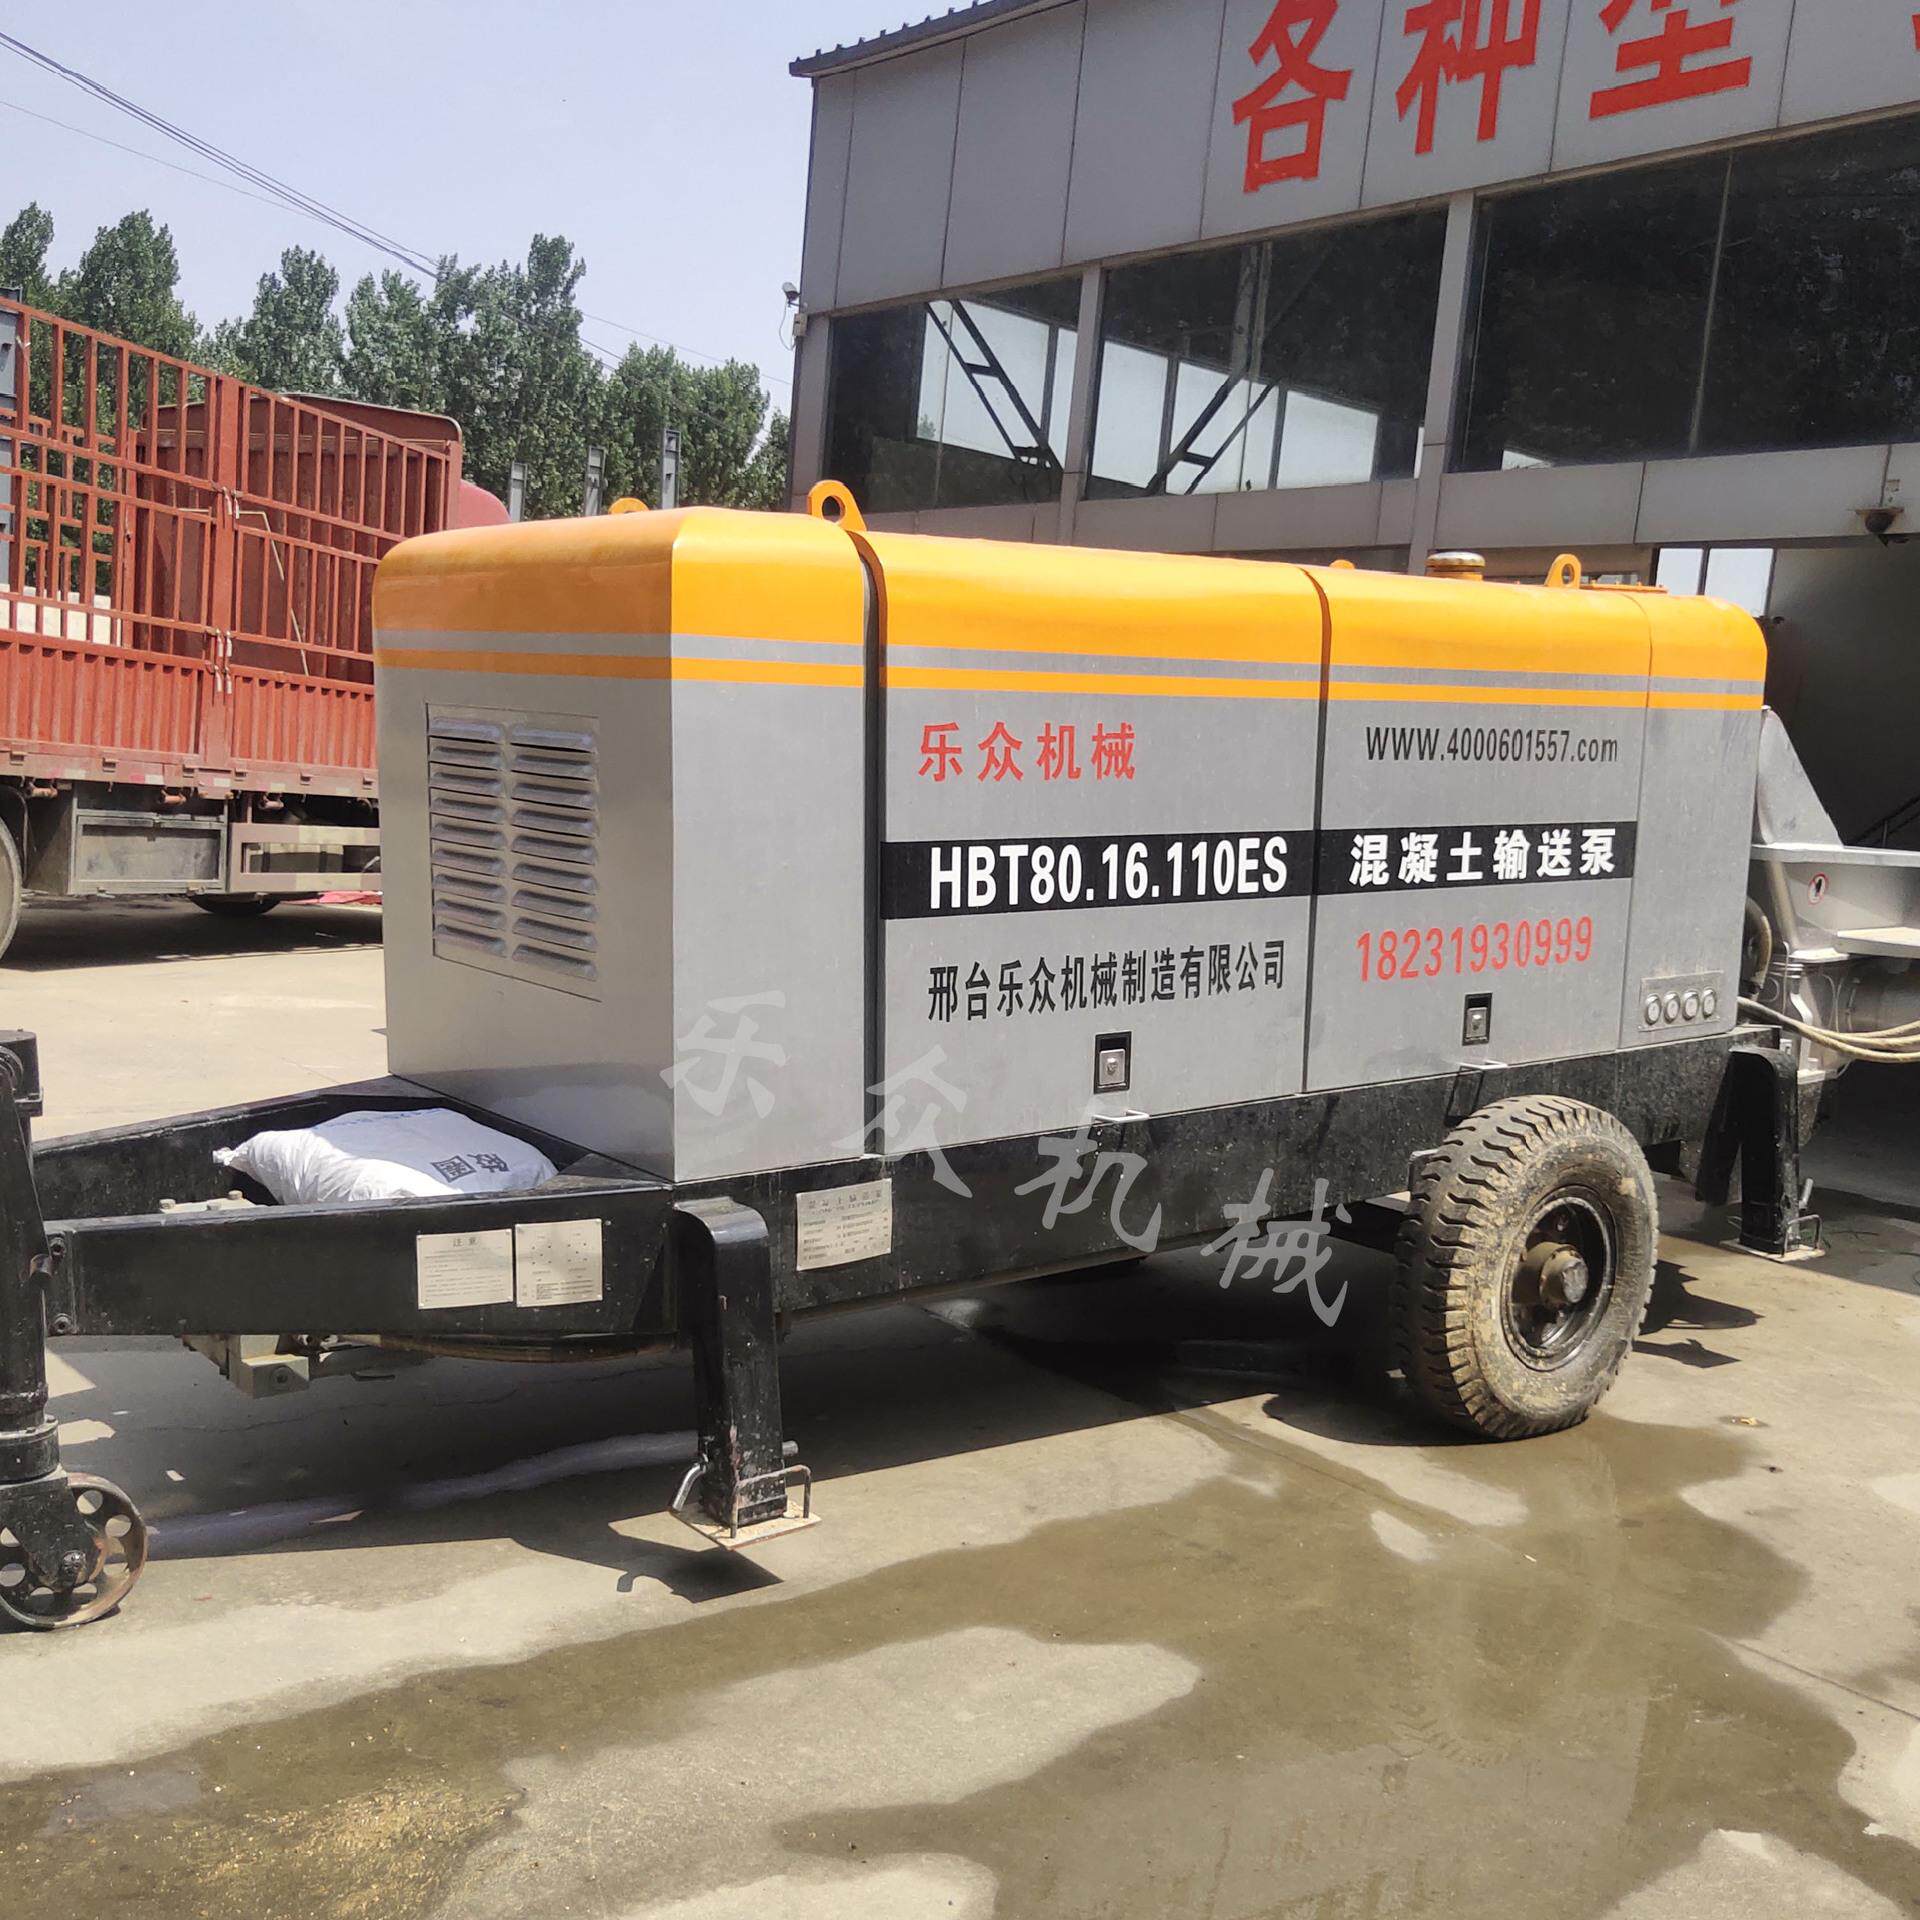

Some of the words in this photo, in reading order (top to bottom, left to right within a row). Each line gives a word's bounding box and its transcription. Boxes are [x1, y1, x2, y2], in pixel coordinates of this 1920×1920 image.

[1232, 0, 1920, 193] 各种型
[918, 721, 1137, 783] 乐众机械
[930, 836, 1288, 909] HBT80.16.110ES
[1349, 828, 1617, 887] 混凝土输送泵
[928, 940, 1285, 1023] 邢台乐众机械制造有限公司
[1356, 915, 1594, 983] 18231930999
